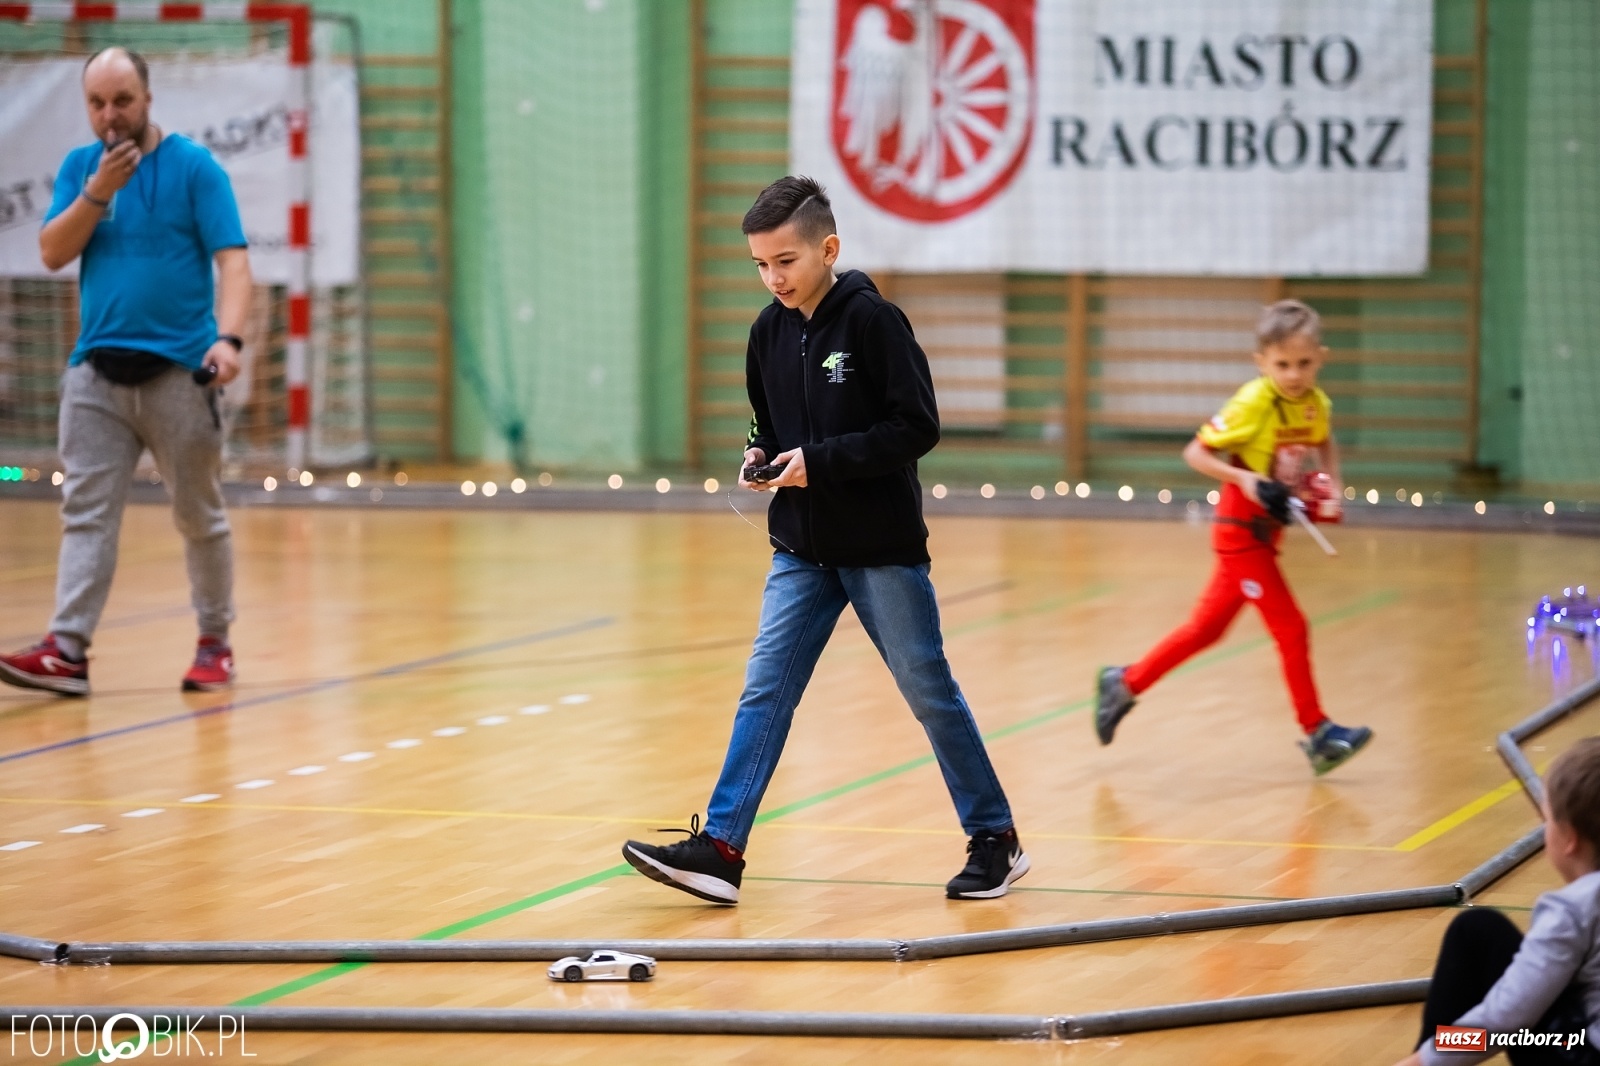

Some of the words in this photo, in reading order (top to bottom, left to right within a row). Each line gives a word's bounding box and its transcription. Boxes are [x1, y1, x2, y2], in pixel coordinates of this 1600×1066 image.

[1095, 34, 1362, 91] MIASTO
[1049, 98, 1408, 172] RACIBÓRZ
[822, 352, 843, 369] 4F
